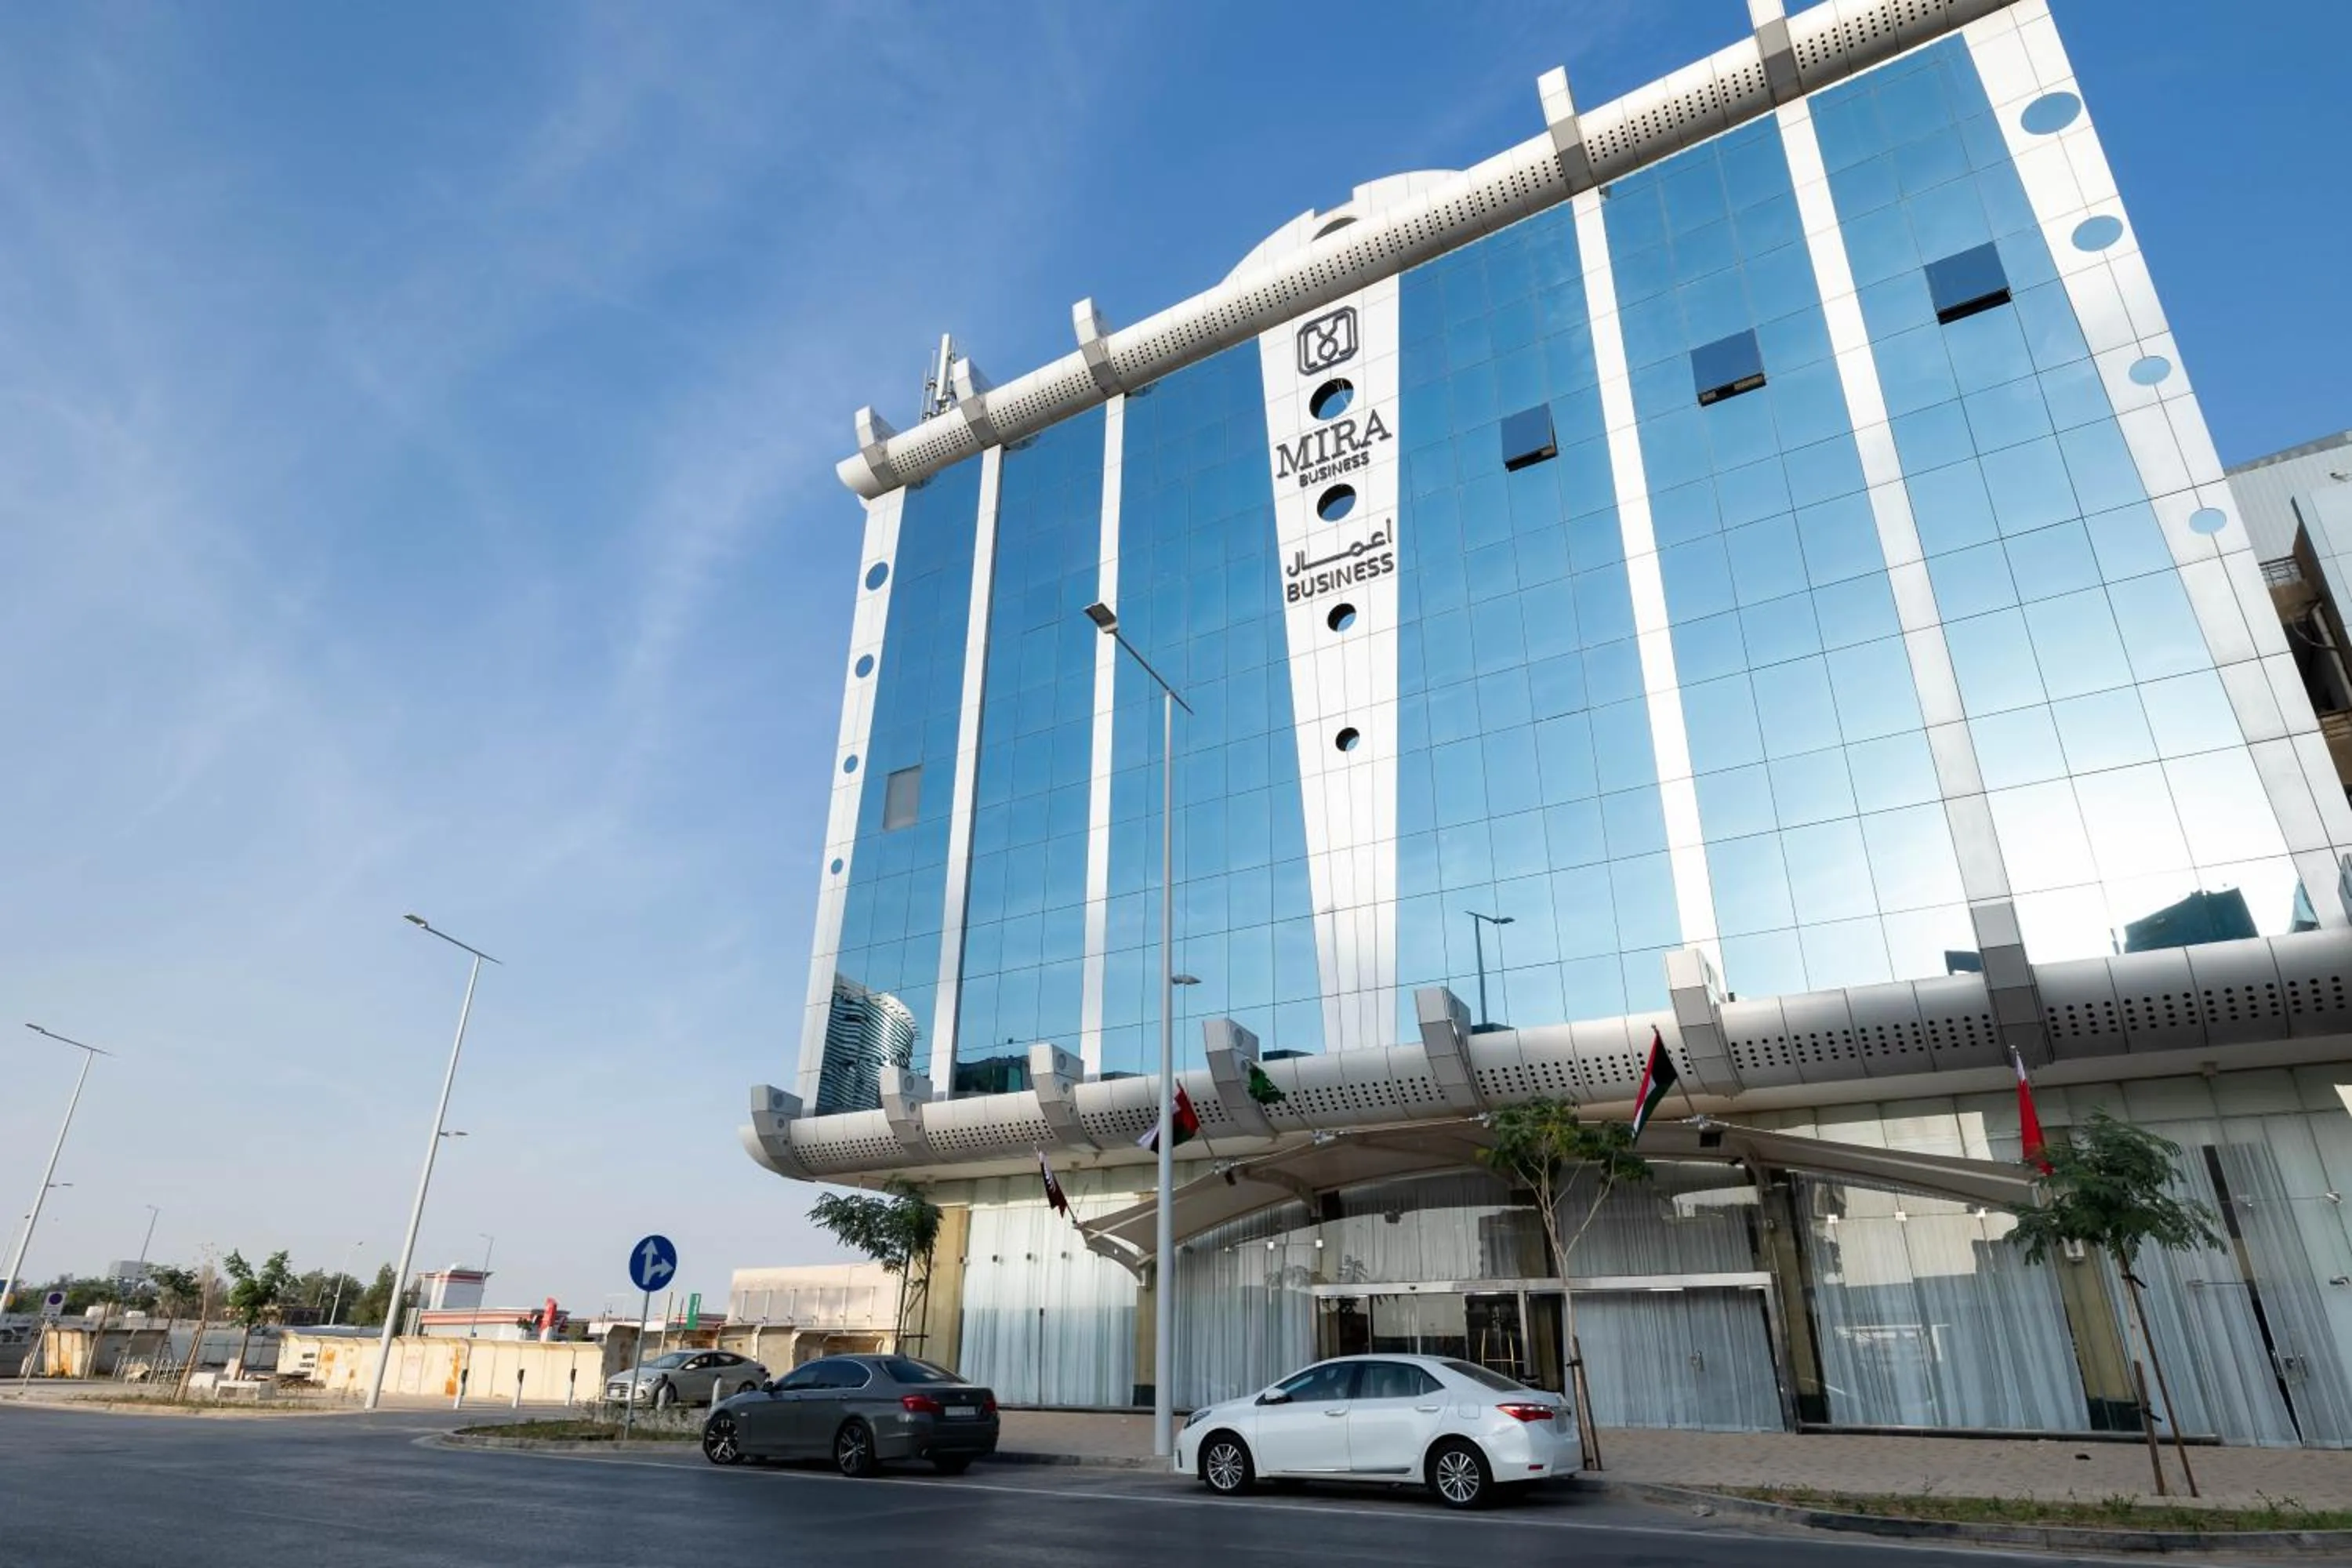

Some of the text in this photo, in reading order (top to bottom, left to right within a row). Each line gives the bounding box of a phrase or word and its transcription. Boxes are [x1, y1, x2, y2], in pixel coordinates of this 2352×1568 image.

[1276, 408, 1392, 478] MIRA
[1299, 452, 1370, 488] BUSINESS
[1287, 552, 1394, 603] BUSINESS
